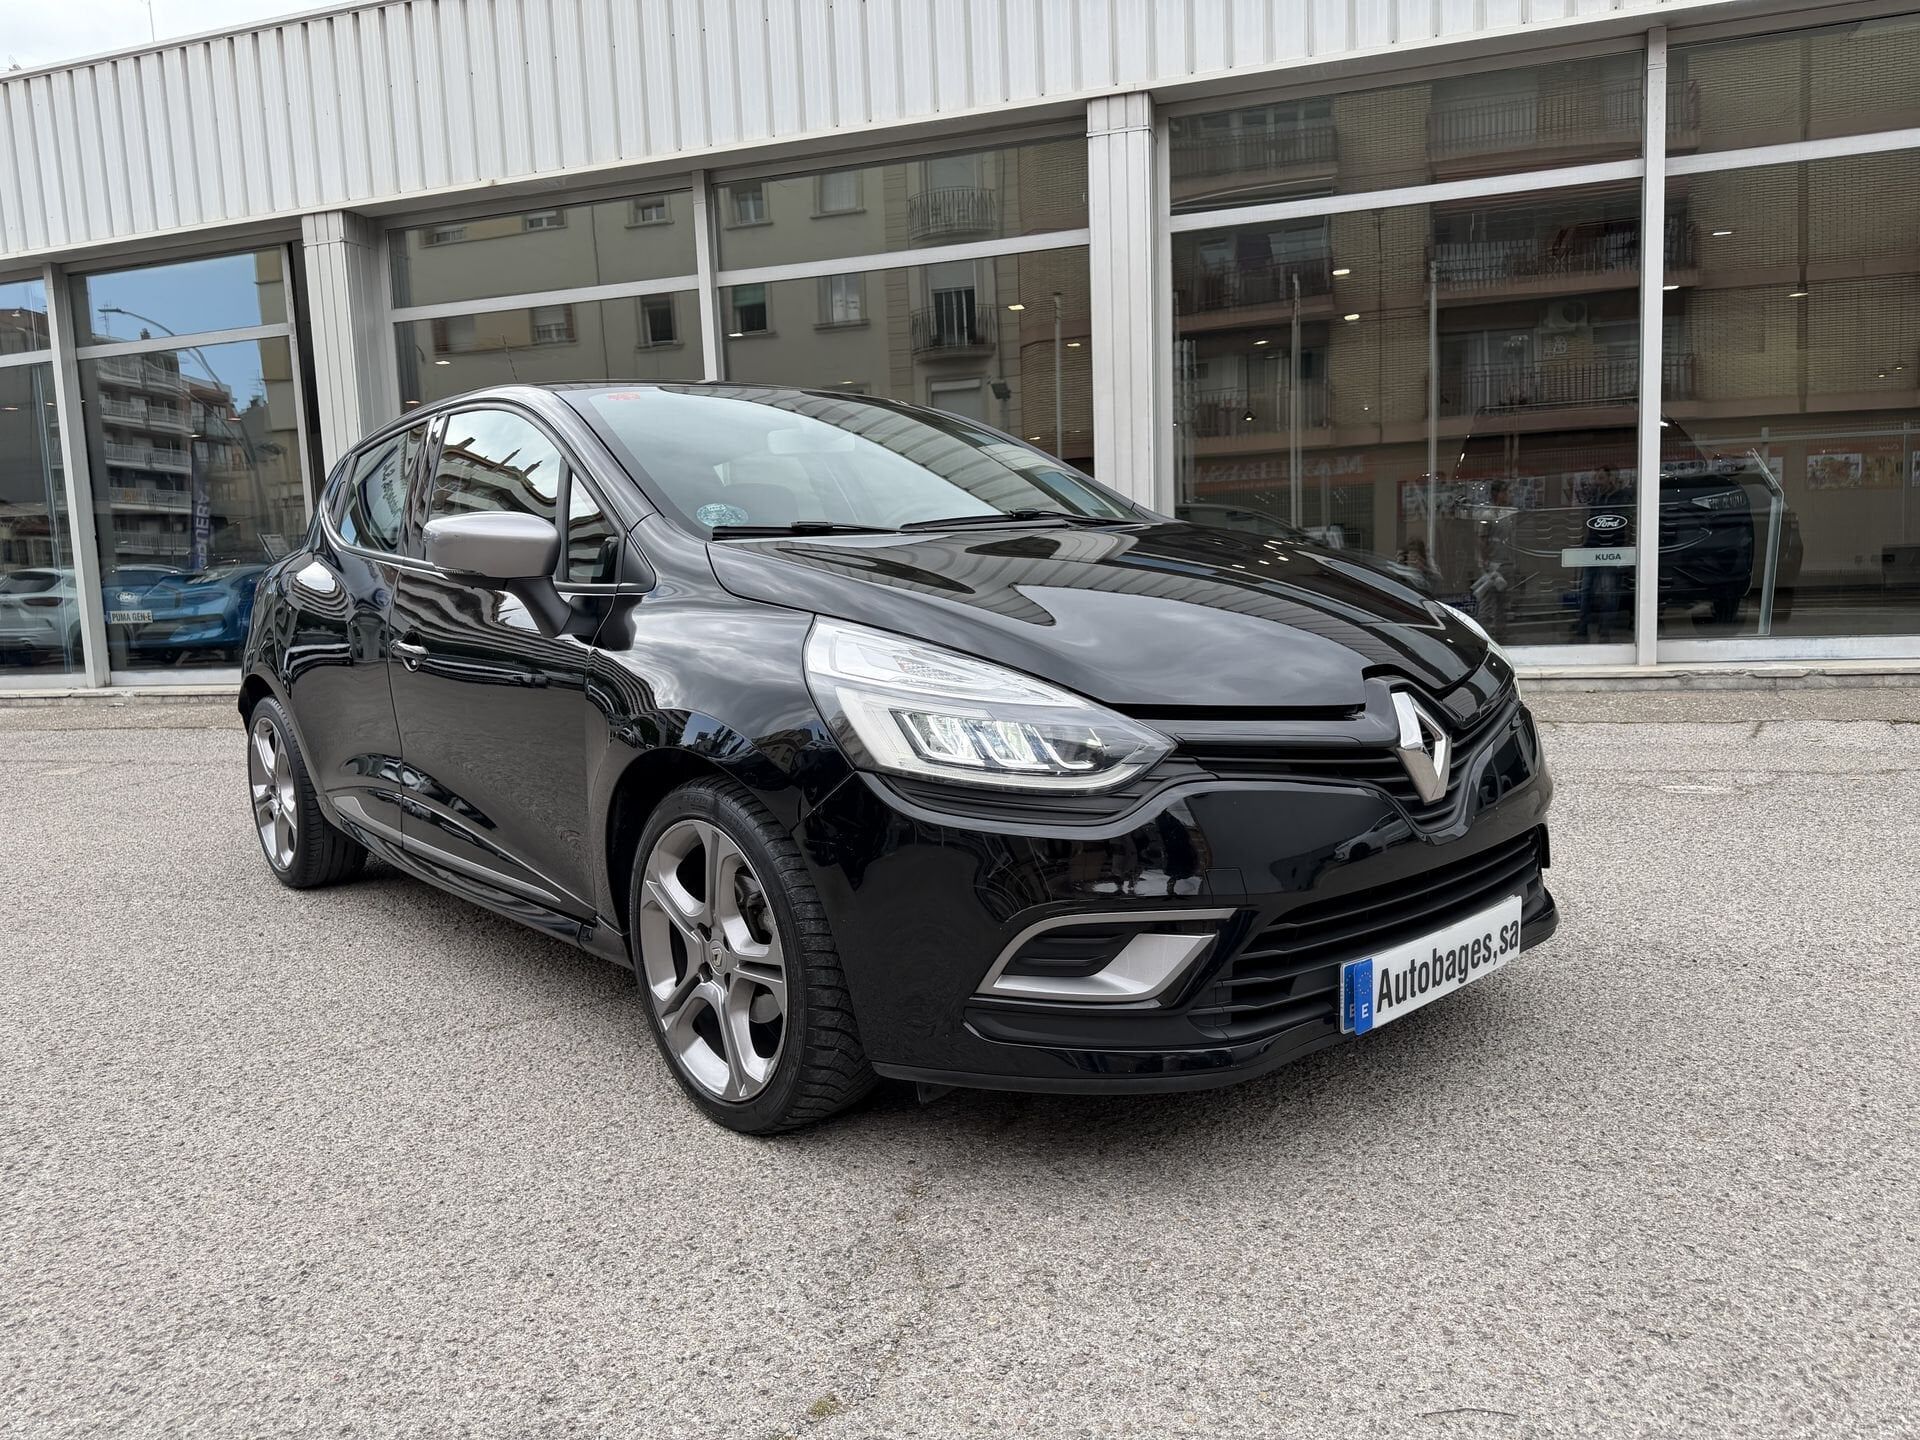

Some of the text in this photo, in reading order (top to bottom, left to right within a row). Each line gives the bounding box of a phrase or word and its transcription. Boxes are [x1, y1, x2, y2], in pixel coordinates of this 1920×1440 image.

[1595, 553, 1621, 561] KUGA
[111, 612, 152, 622] PUMA GEN-E
[1361, 1002, 1369, 1019] E
